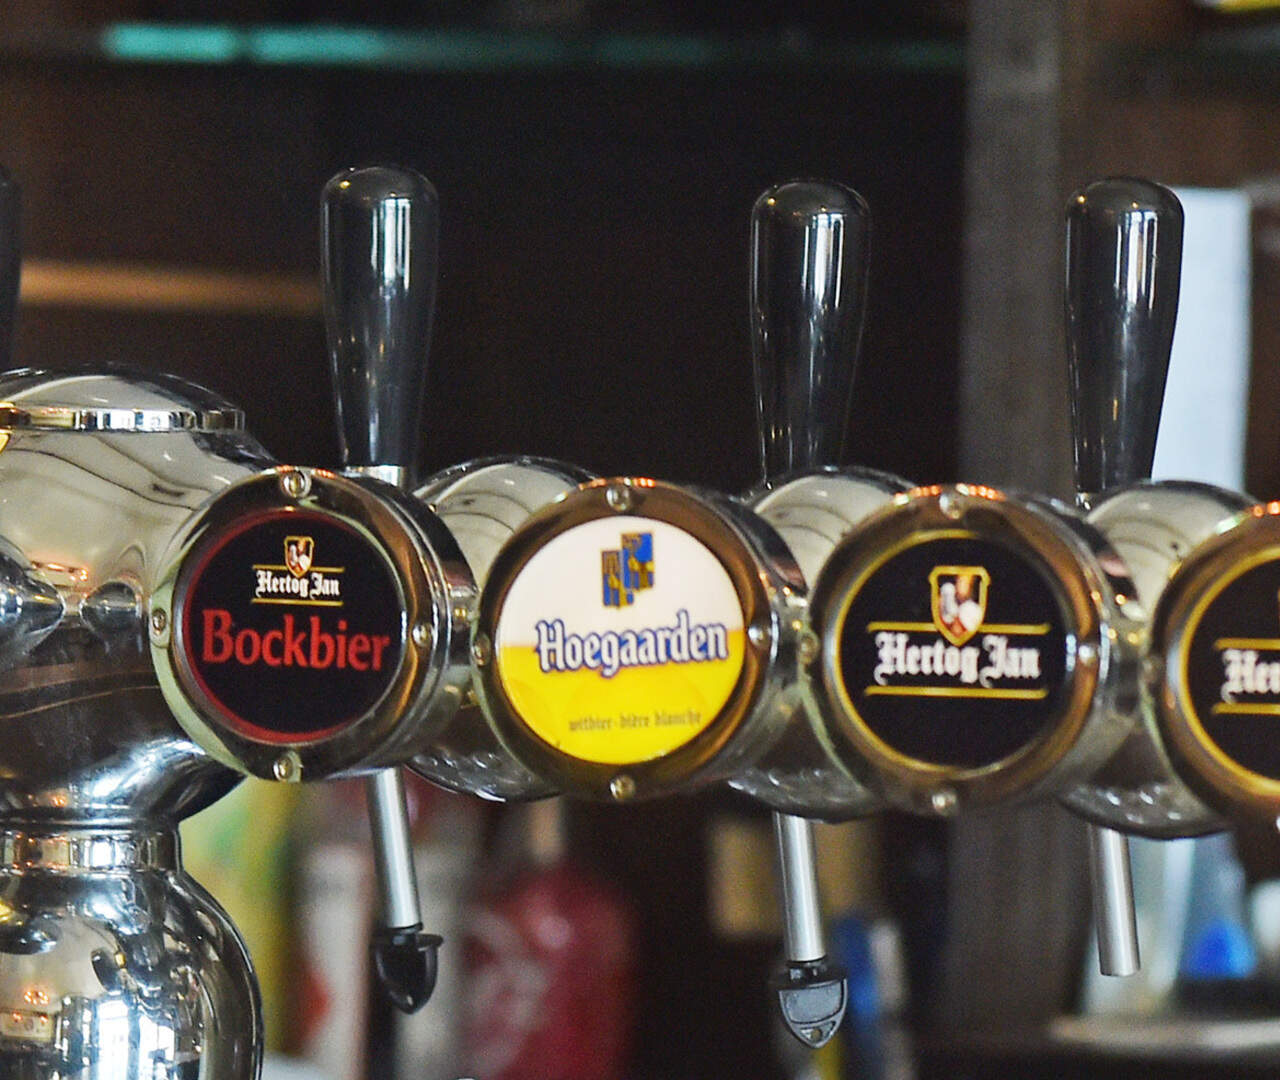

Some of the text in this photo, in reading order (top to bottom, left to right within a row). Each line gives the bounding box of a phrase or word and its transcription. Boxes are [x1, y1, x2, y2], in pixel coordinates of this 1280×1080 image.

[255, 570, 341, 600] Hertog Jan
[202, 609, 391, 671] Bockbier
[534, 608, 728, 678] Hoegaarden
[873, 631, 1041, 689] Hertog Jan
